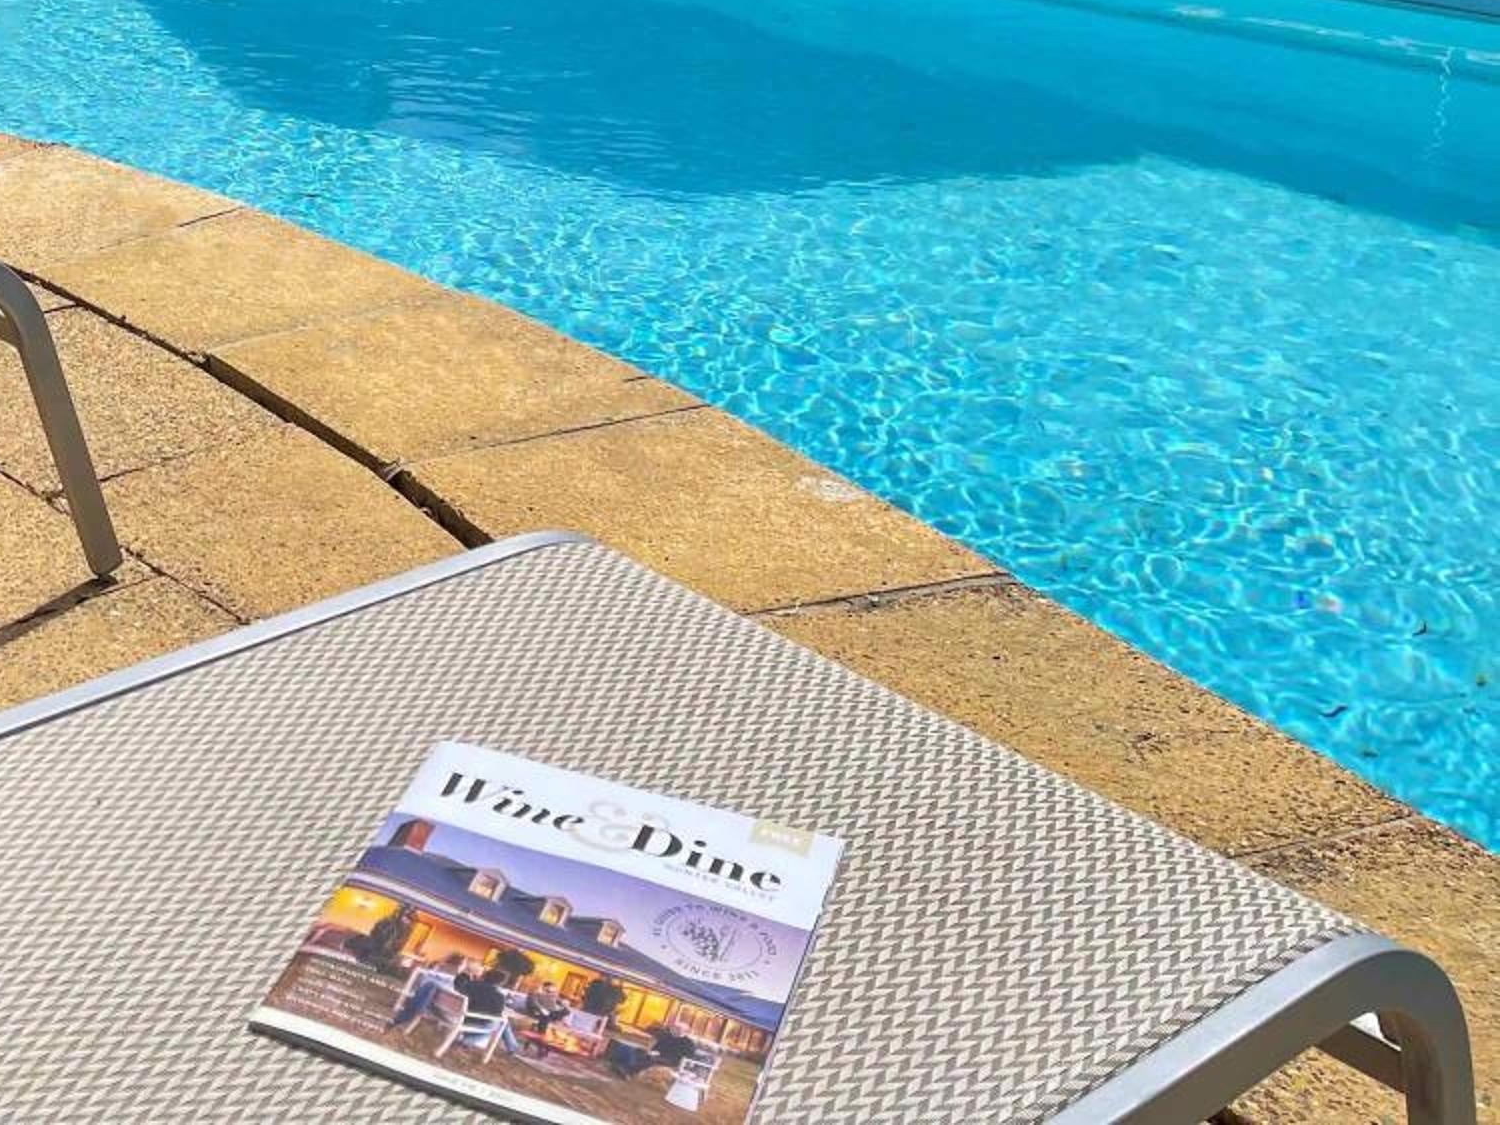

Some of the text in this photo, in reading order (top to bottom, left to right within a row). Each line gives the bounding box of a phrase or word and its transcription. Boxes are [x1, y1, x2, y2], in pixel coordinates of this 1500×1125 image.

[440, 772, 781, 891] Wine & Dine
